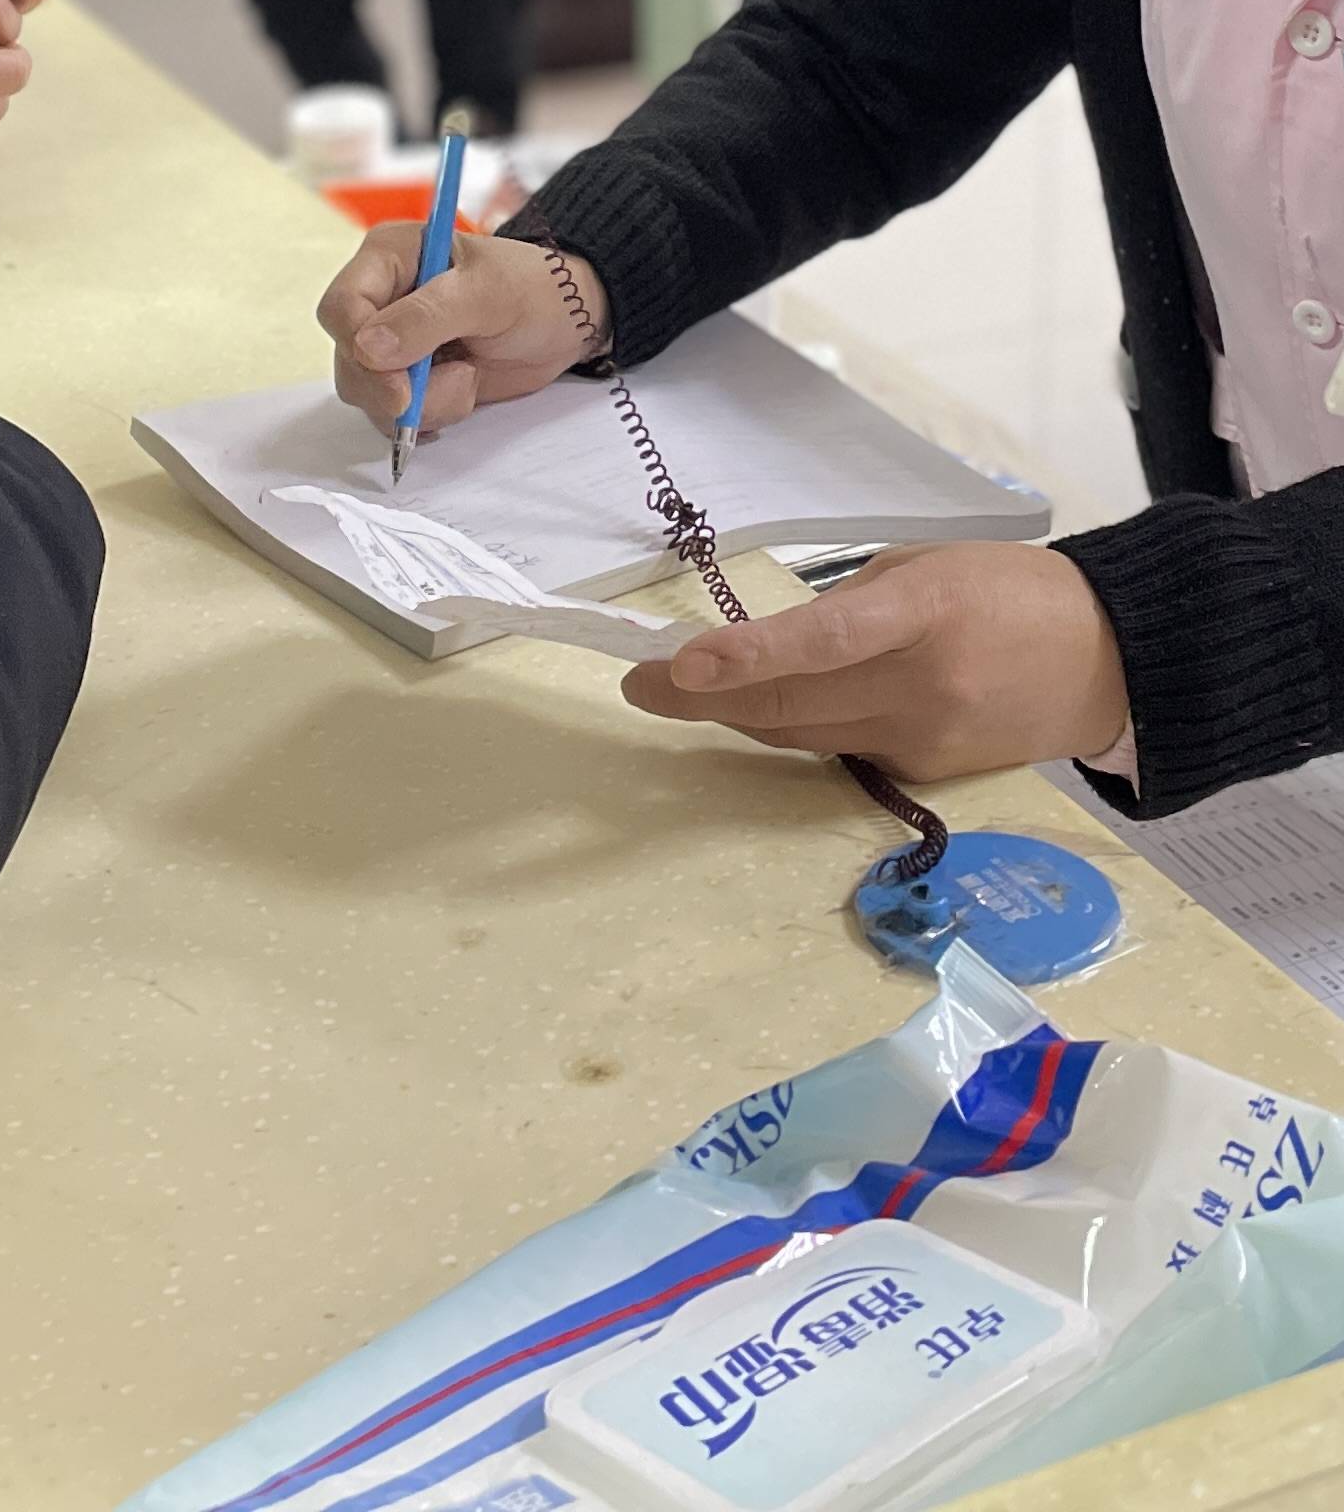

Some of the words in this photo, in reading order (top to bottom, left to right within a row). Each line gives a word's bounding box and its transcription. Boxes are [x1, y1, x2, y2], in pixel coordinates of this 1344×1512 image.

[659, 1277, 925, 1430] 消毒湿巾
[914, 1304, 1006, 1370] 卓氏
